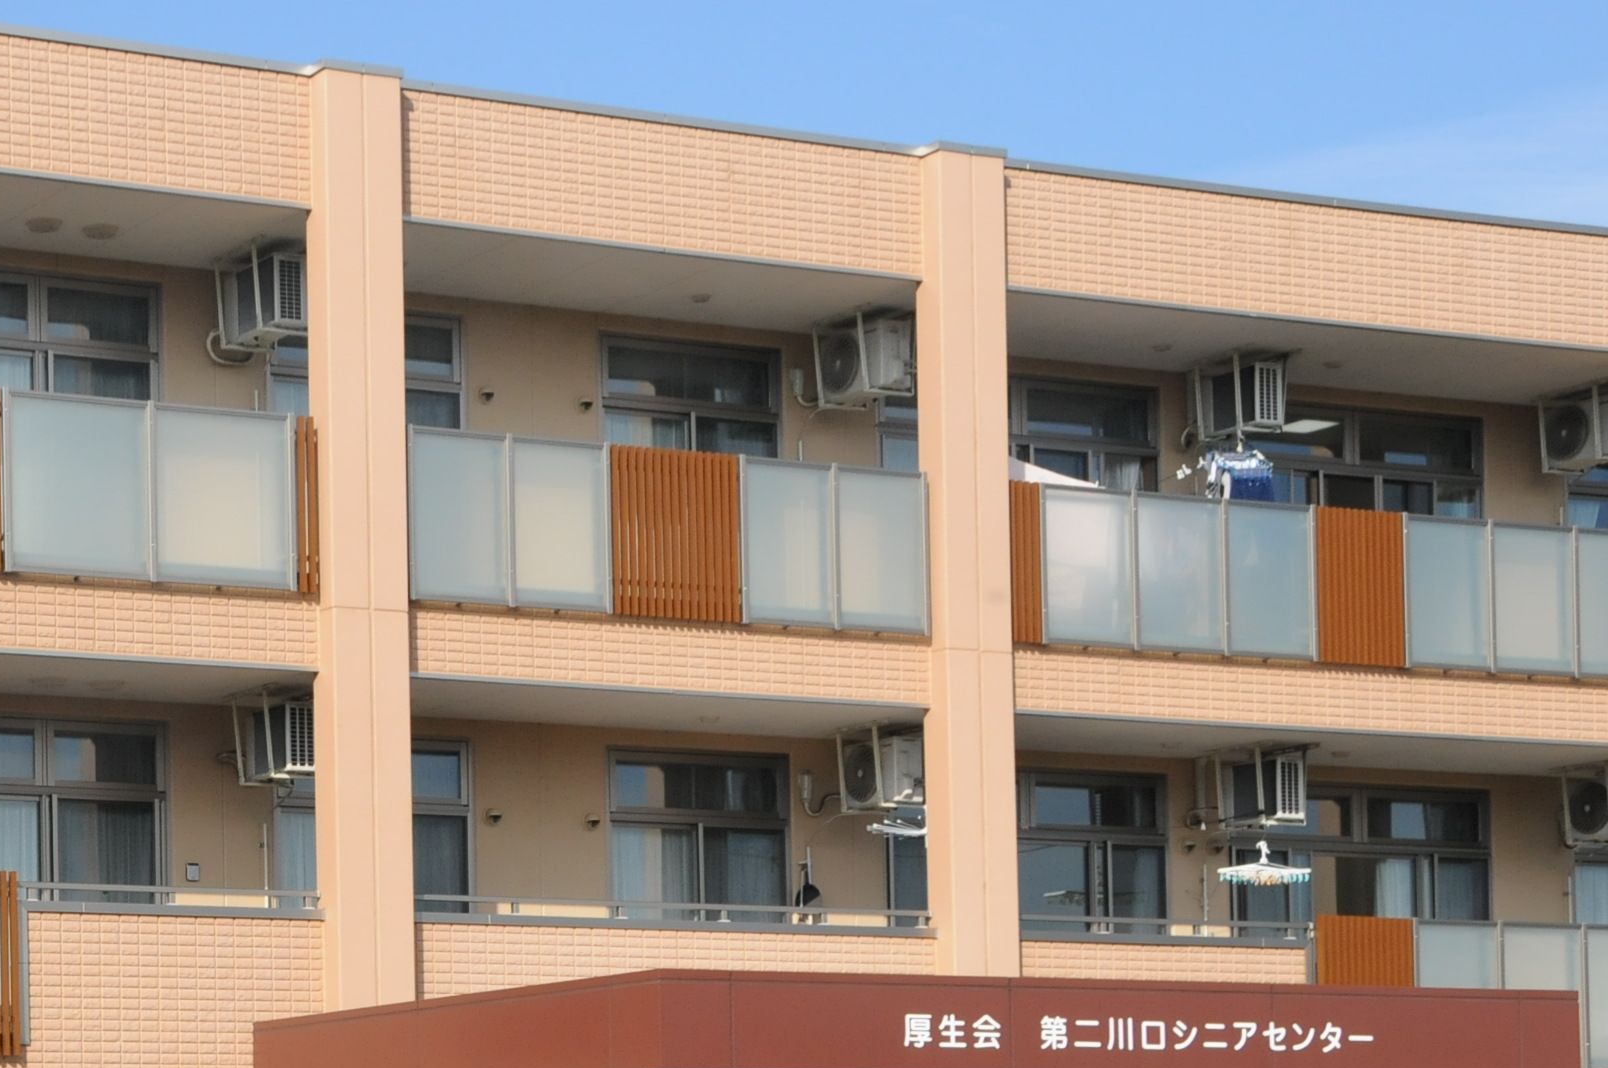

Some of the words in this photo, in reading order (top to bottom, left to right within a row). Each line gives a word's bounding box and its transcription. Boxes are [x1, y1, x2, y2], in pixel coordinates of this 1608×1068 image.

[904, 1013, 1001, 1049] 厚生会
[1040, 1015, 1374, 1053] 第二川口シニアセンター
